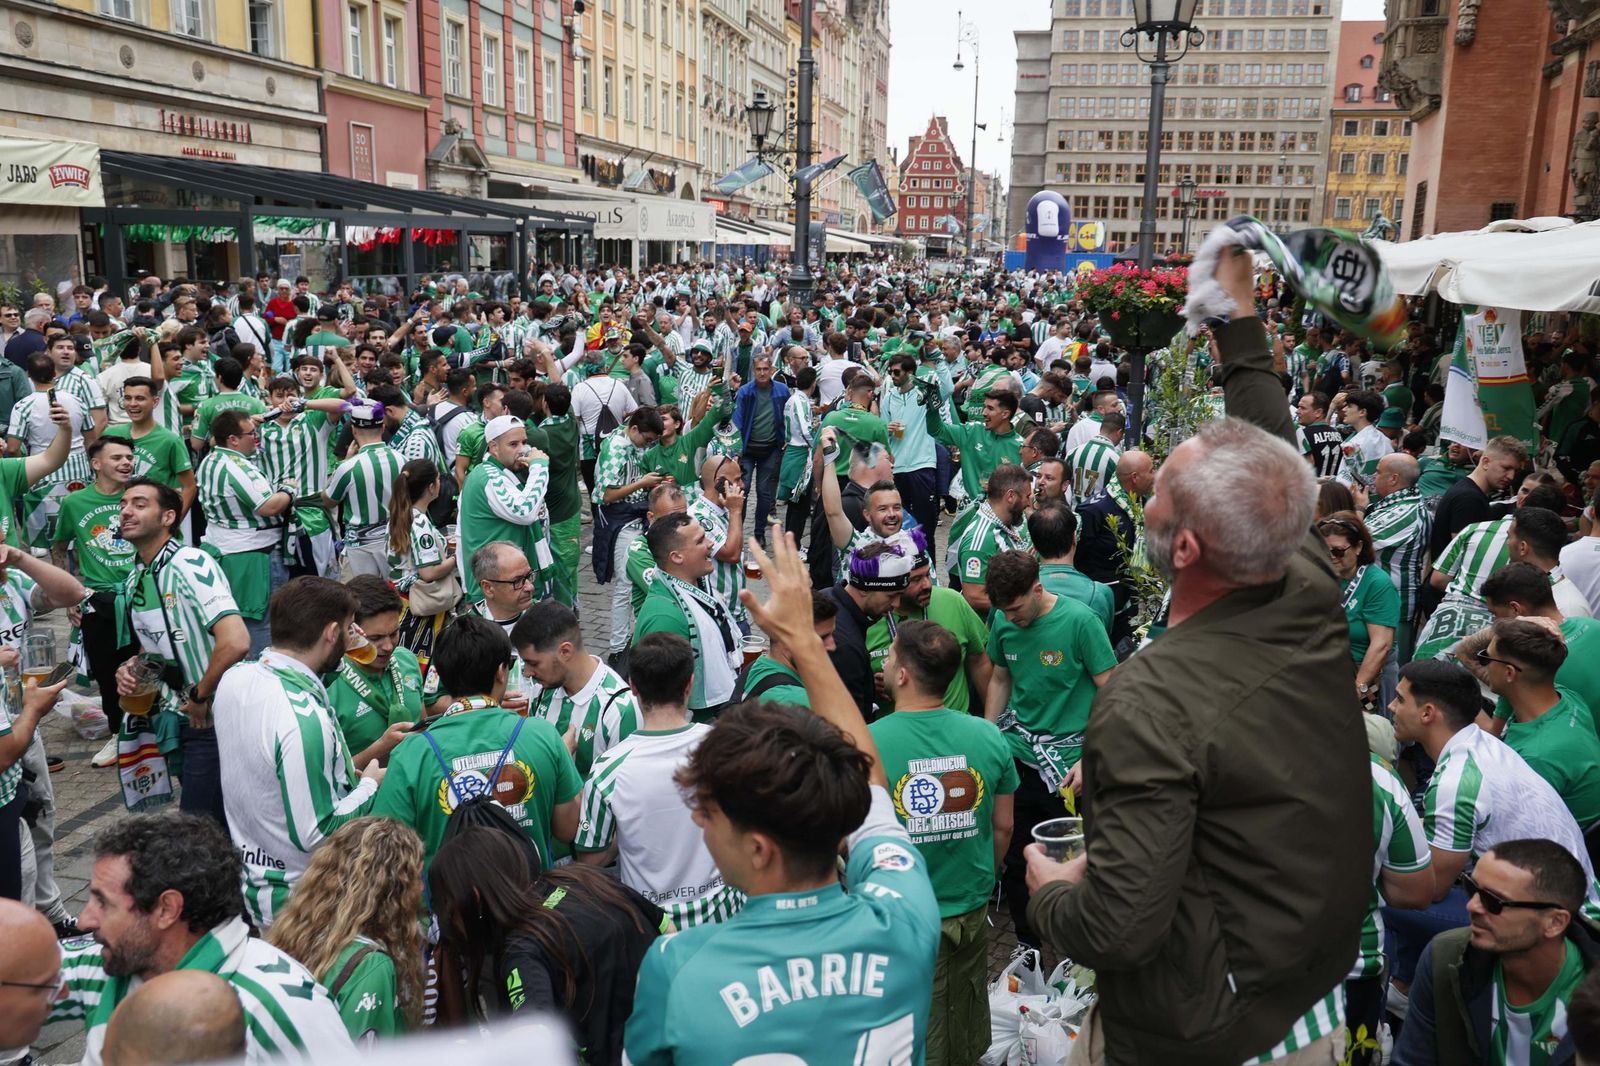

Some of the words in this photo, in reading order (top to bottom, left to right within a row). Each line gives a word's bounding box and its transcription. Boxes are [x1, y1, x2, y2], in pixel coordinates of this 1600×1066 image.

[7, 164, 38, 184] JARS
[53, 166, 87, 183] ŻYWIEC
[1313, 431, 1344, 444] ALFONS
[1320, 444, 1341, 476] 11
[1074, 466, 1100, 497] 17
[342, 662, 372, 698] FINAL
[907, 817, 929, 833] DEL
[931, 811, 976, 831] ARISCAL
[942, 832, 951, 841] HAY
[952, 831, 962, 839] QUE
[719, 952, 889, 1028] BARRIE
